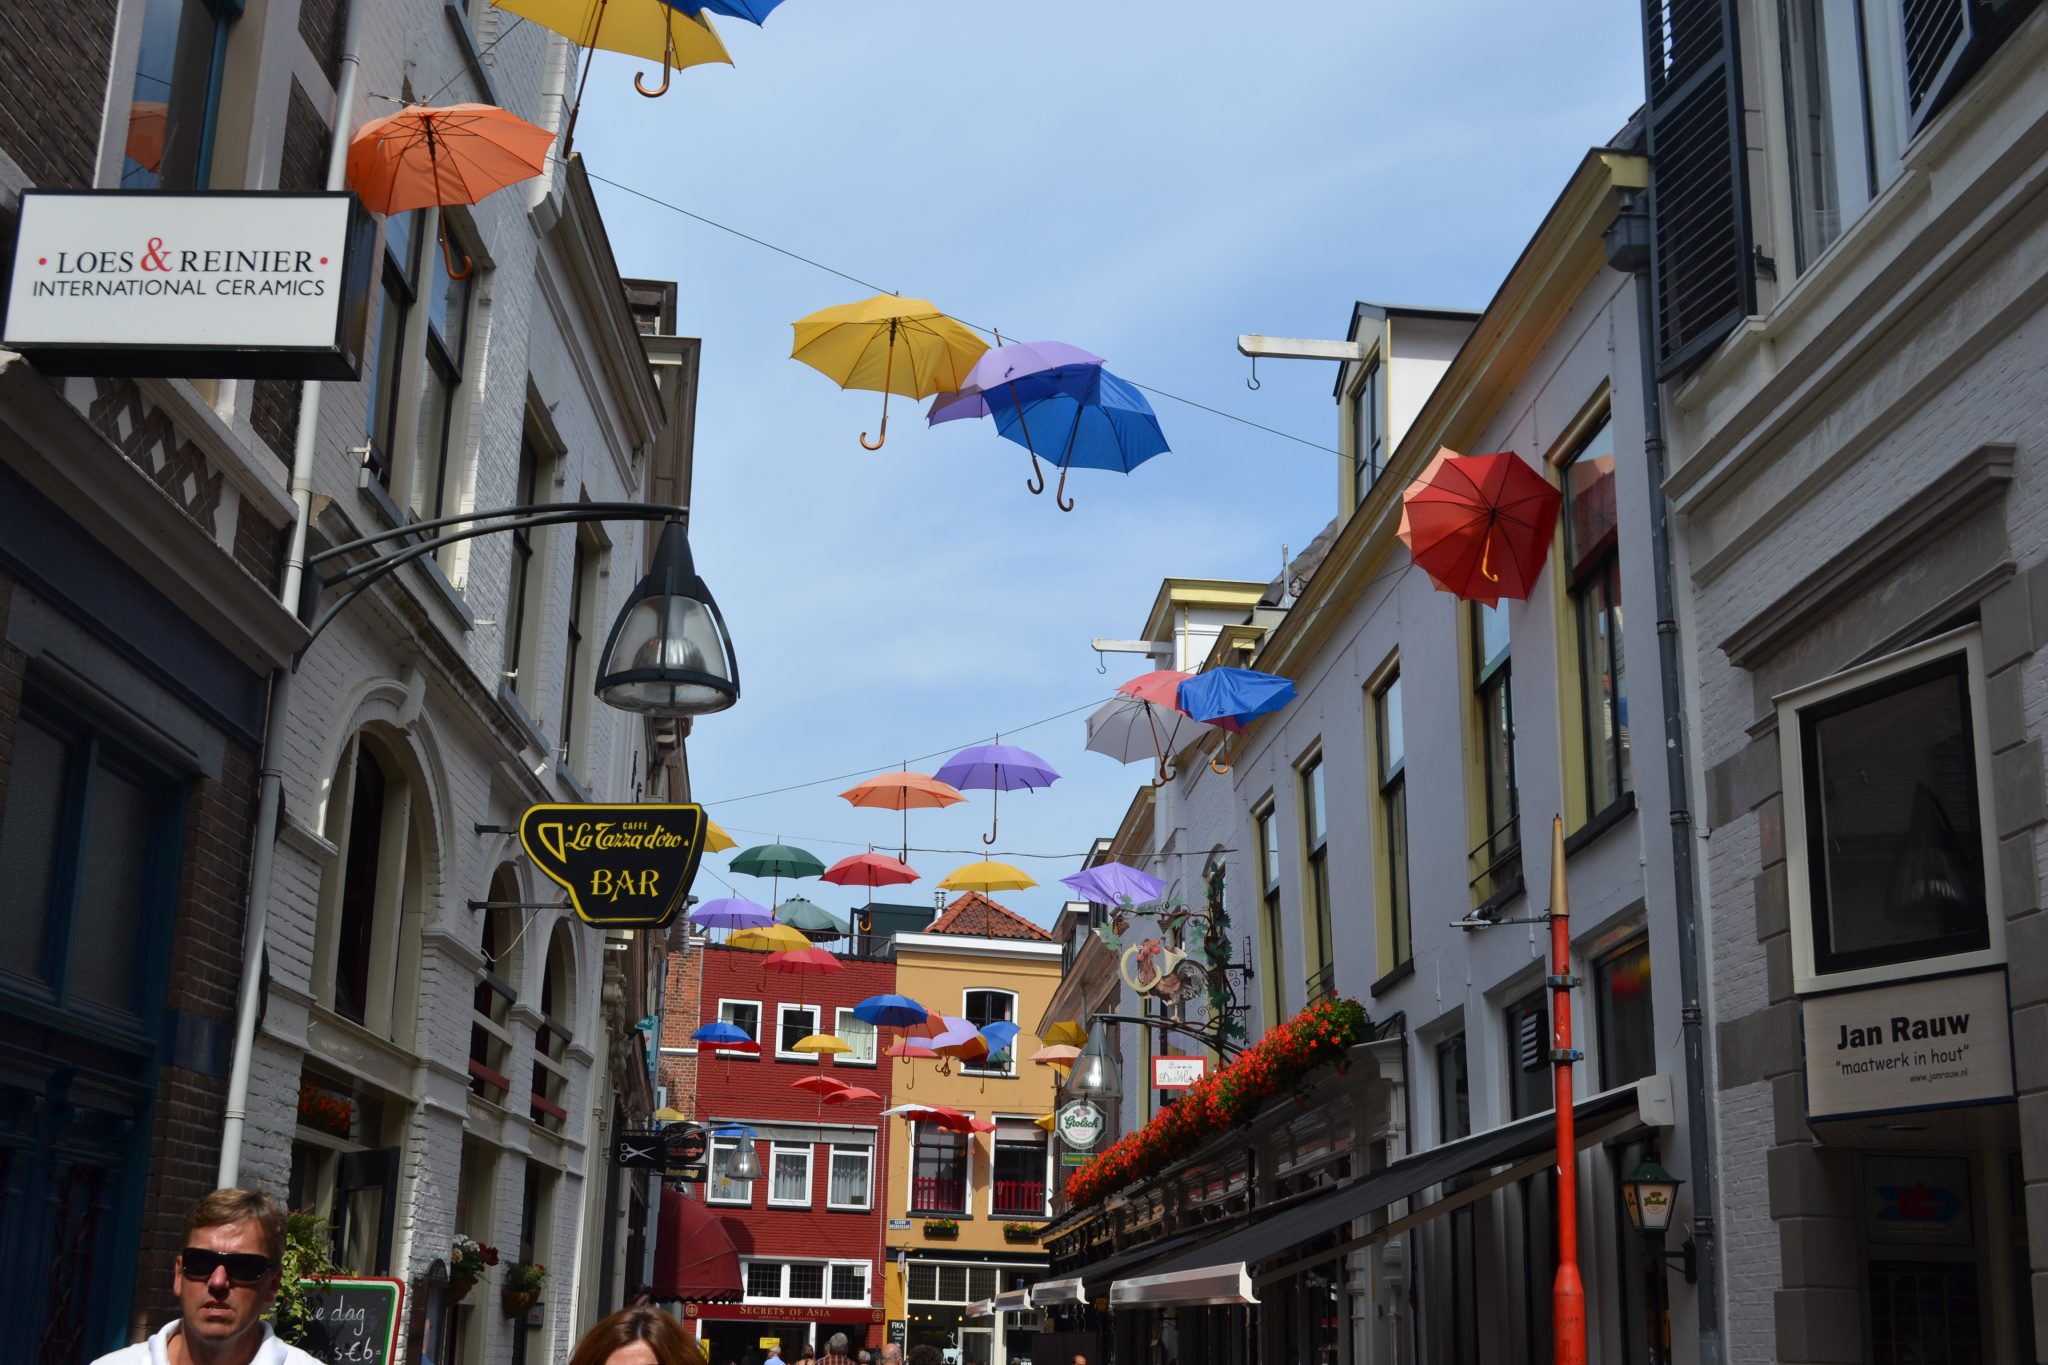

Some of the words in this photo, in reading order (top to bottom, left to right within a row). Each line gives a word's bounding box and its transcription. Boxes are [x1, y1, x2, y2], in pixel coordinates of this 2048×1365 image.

[56, 251, 134, 274] LOES
[140, 237, 173, 272] &
[179, 251, 314, 272] REINIER
[33, 280, 206, 297] INTERNATIONAL
[216, 280, 325, 297] CERAMICS
[565, 823, 594, 851] La
[595, 822, 645, 850] Tazza
[643, 825, 682, 849] d'oro
[590, 869, 660, 903] BAR
[1837, 1024, 1883, 1050] Jan
[1891, 1013, 1970, 1043] Rauw
[1835, 1053, 1909, 1076] "maatwerk
[1914, 1051, 1927, 1066] in
[1931, 1044, 1970, 1064] hout"
[1909, 1068, 1968, 1083] www.janrauw.nl
[1064, 1115, 1099, 1129] Grolsch
[331, 1294, 366, 1336] dag
[740, 1305, 785, 1316] SECRETS
[789, 1308, 802, 1316] OF
[807, 1308, 830, 1317] ASIA
[891, 1321, 905, 1329] FIKA
